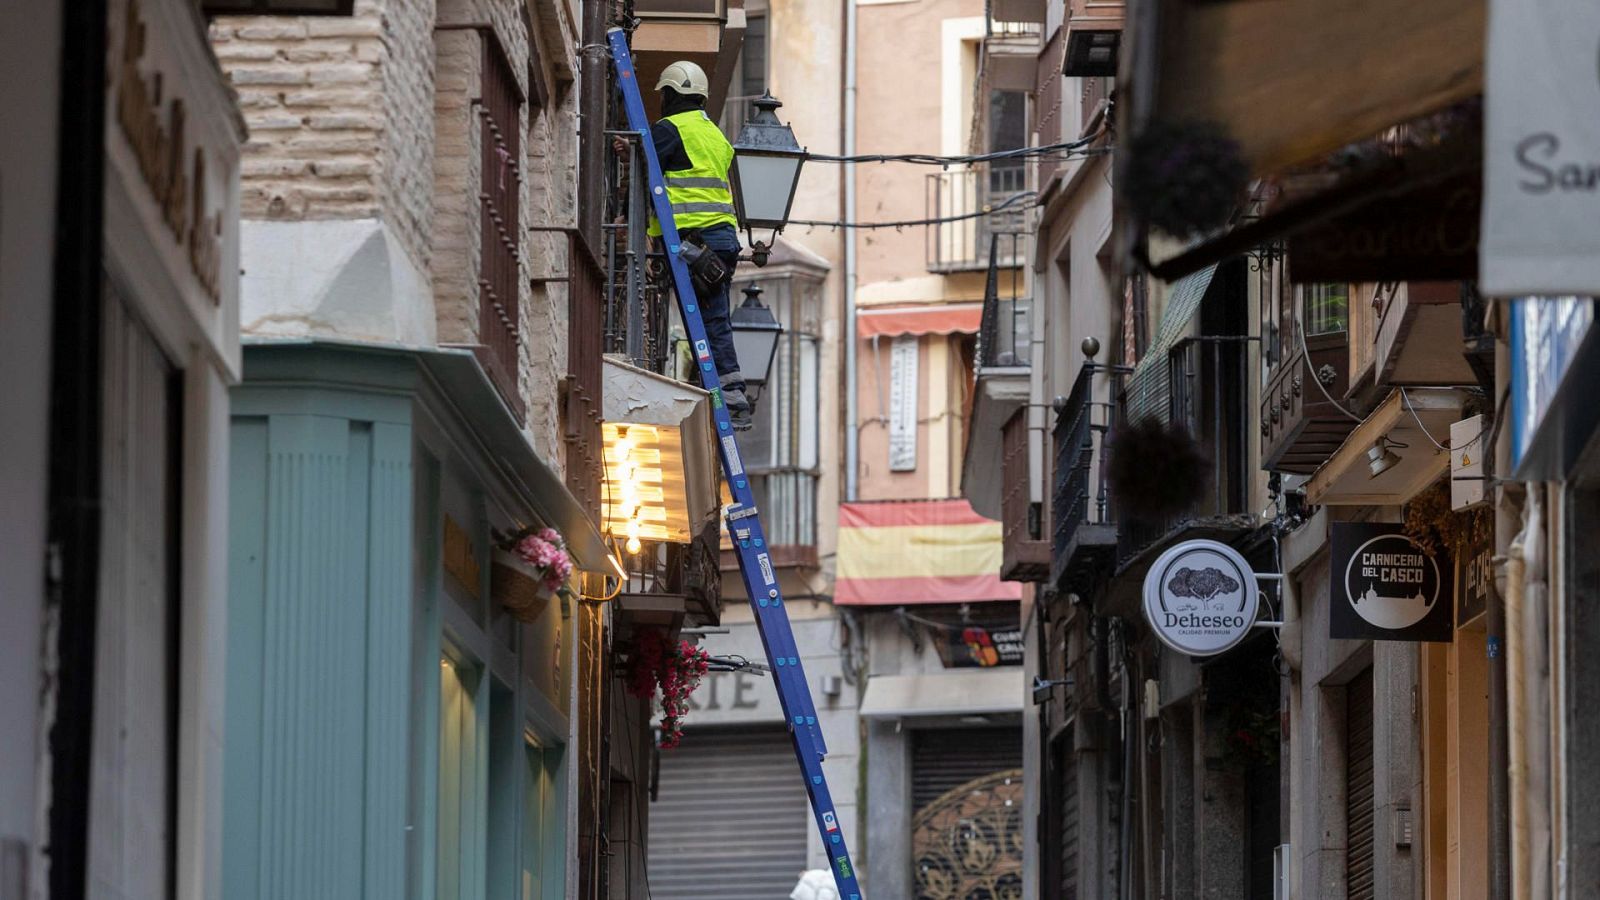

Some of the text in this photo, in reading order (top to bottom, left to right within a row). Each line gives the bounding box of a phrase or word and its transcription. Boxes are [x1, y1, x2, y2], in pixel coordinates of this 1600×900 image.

[1362, 553, 1424, 566] CARNICERIA
[1362, 567, 1423, 583] DEL CASCO
[1164, 612, 1244, 628] Deheseo
